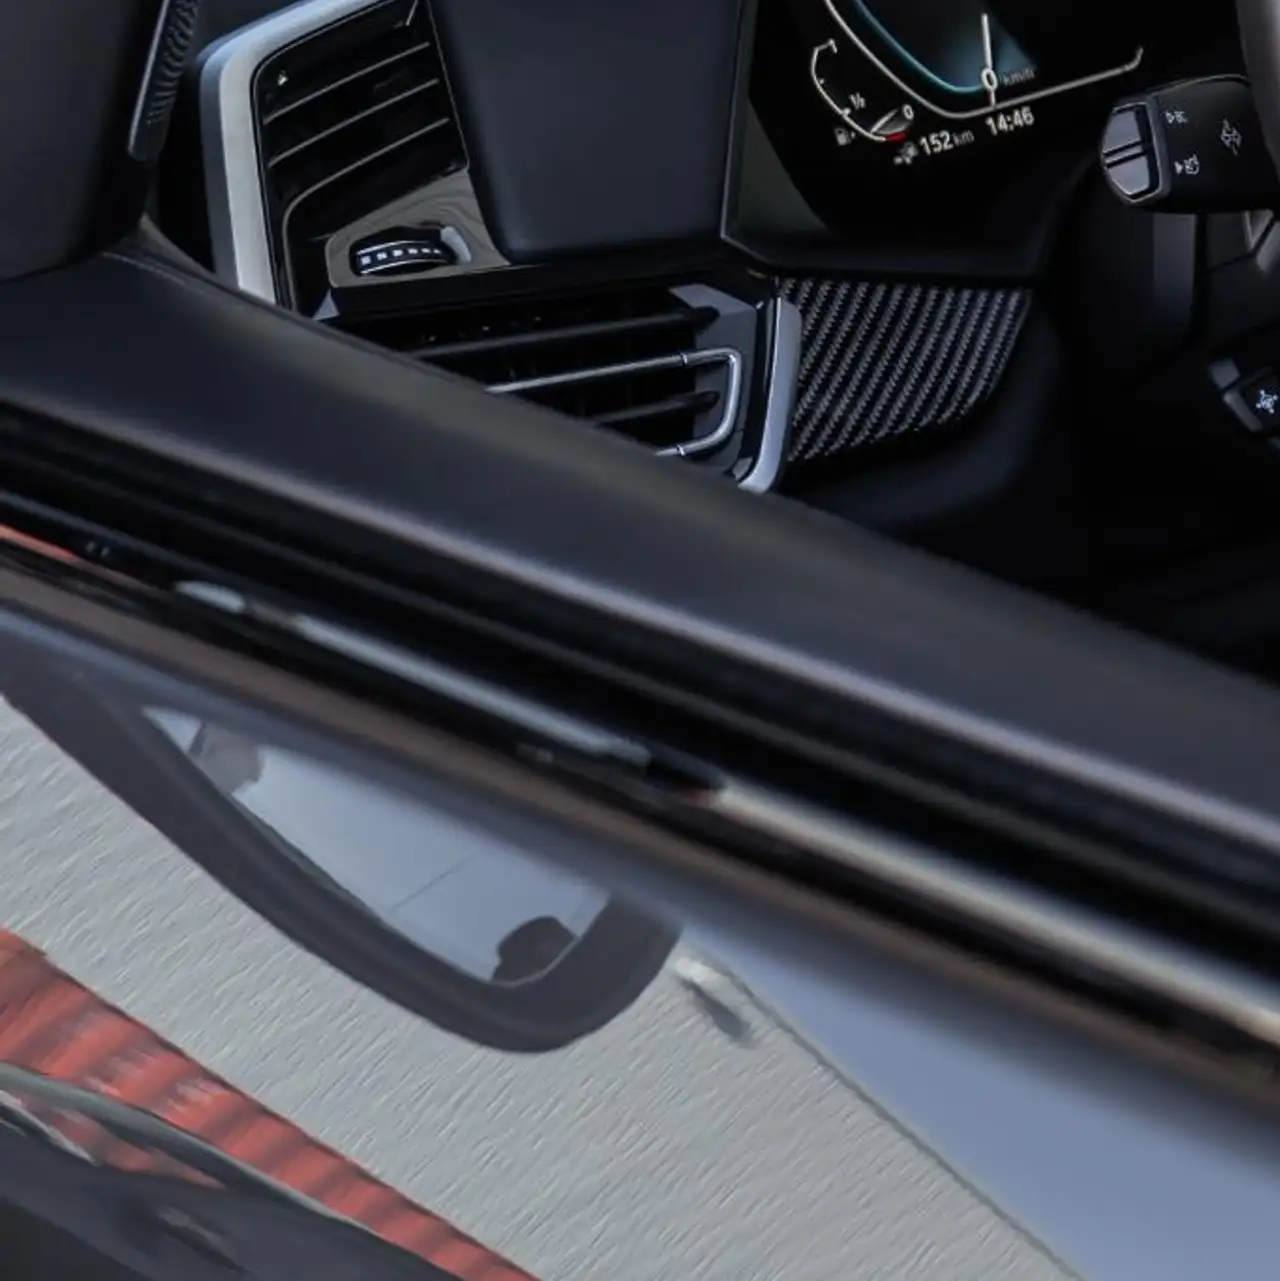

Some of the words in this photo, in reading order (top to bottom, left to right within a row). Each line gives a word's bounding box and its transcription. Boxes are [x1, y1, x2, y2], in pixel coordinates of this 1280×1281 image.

[981, 69, 998, 91] 0
[984, 106, 1035, 135] 14:46
[919, 130, 954, 156] 152
[953, 129, 976, 147] km
